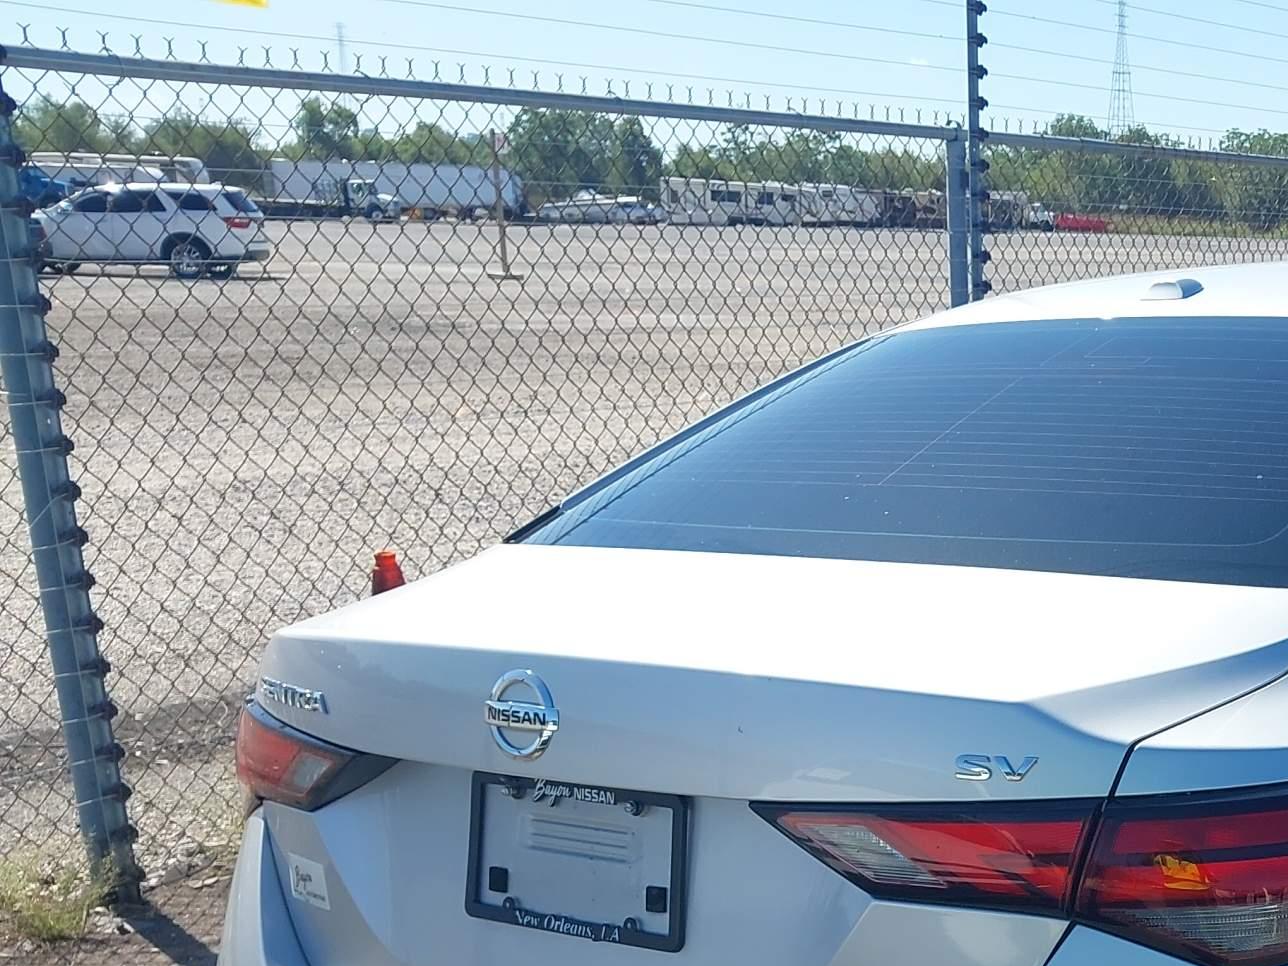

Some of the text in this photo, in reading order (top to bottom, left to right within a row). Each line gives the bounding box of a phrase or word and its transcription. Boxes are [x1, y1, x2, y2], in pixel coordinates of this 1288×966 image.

[487, 705, 546, 726] NISSAN
[955, 754, 1040, 782] SV
[573, 786, 615, 805] NISSAN
[515, 909, 540, 926] New
[543, 914, 595, 939] Orleans,
